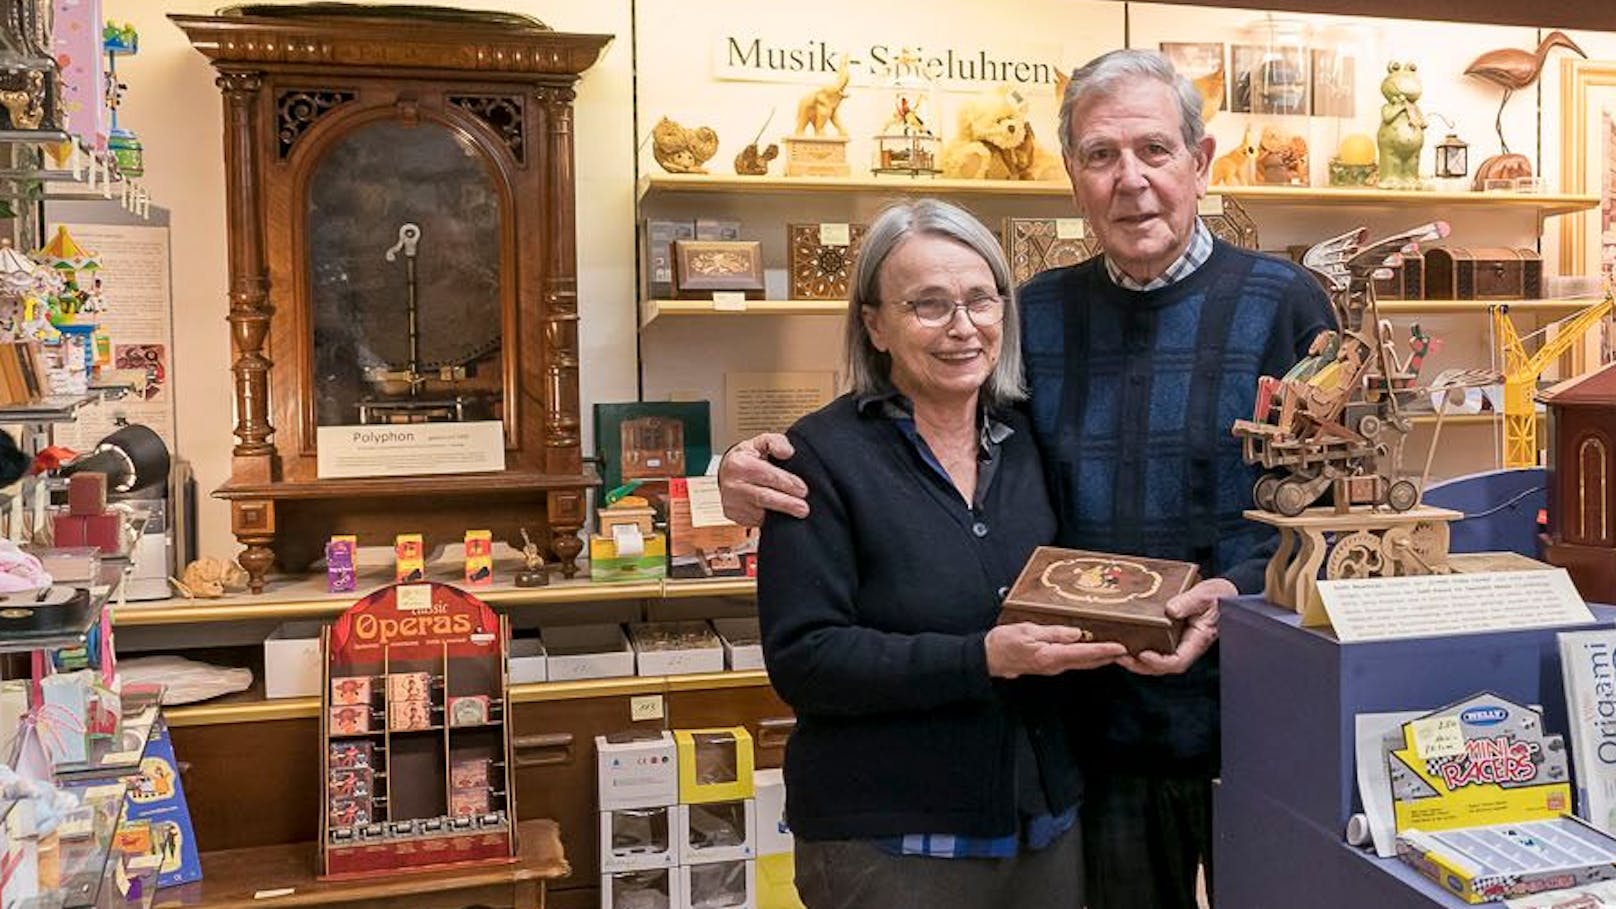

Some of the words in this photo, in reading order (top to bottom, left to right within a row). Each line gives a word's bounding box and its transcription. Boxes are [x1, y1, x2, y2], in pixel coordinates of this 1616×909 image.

[352, 431, 416, 444] Polyphon
[355, 613, 472, 644] Operas
[1460, 736, 1509, 761] MINI
[1441, 758, 1537, 790] RACERS
